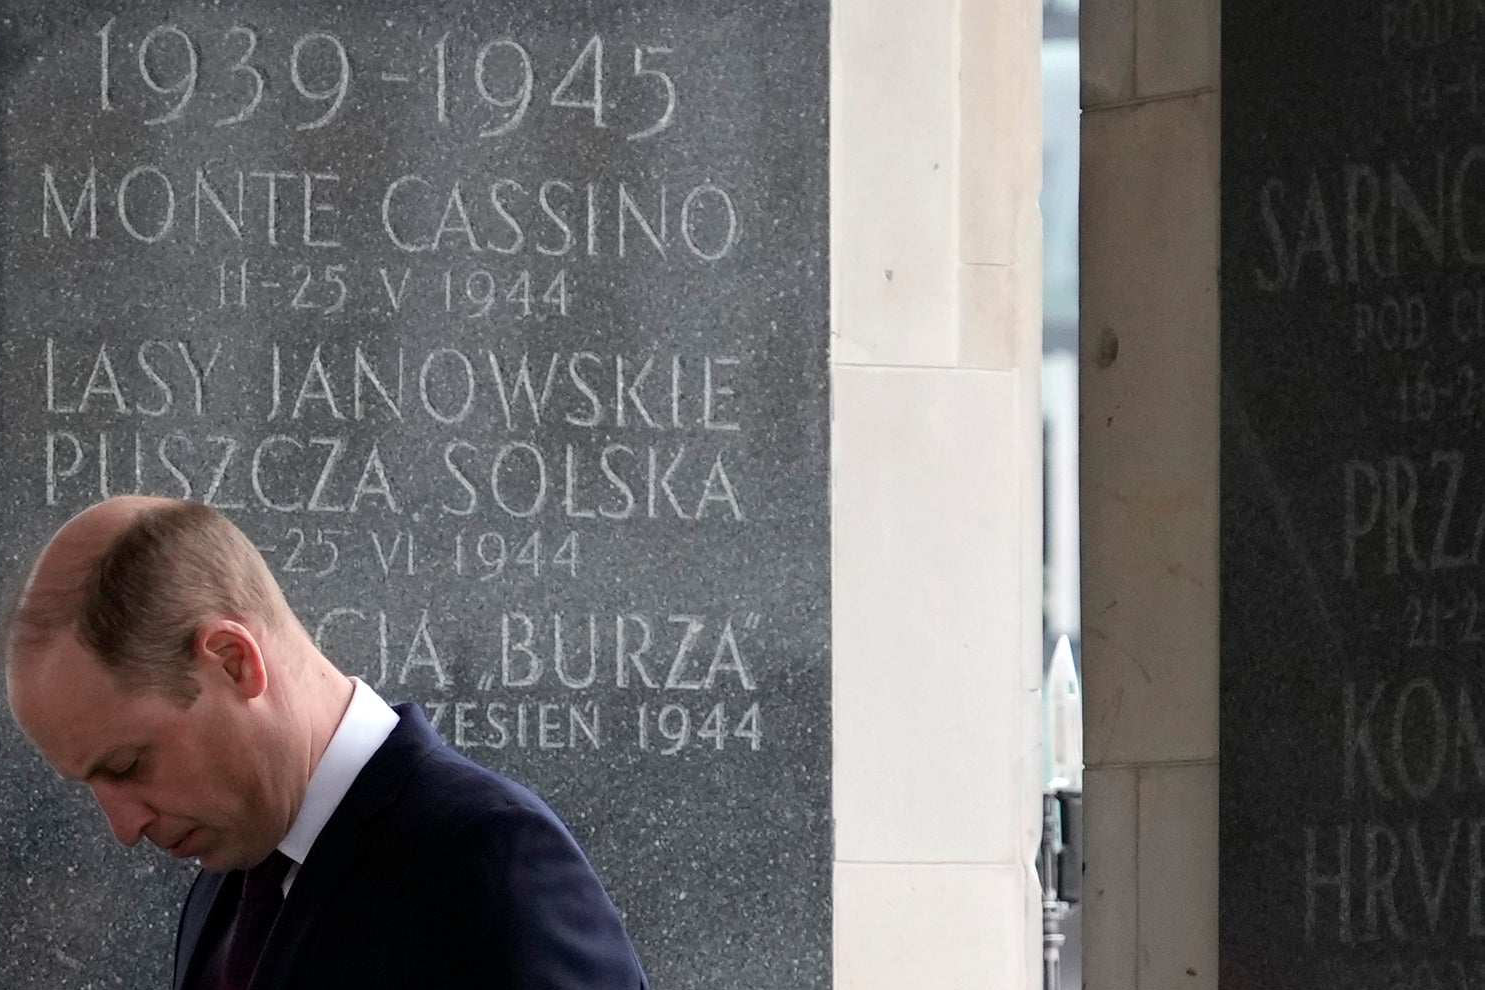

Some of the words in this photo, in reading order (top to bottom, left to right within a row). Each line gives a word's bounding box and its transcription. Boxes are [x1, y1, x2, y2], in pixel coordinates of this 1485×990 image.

[97, 18, 679, 142] 1939-1945
[41, 164, 341, 247] MONTE
[380, 173, 741, 261] CASSINO
[379, 266, 411, 314] V
[443, 266, 571, 317] 1944
[46, 335, 223, 417] LASY
[266, 341, 743, 431] JANOWSKIE
[46, 431, 402, 512] PUSZCZA
[443, 441, 746, 522] SOLSKA
[1342, 450, 1485, 581] PRZ
[371, 530, 416, 578] VI
[454, 530, 581, 582] 1944
[638, 701, 762, 756] 1944
